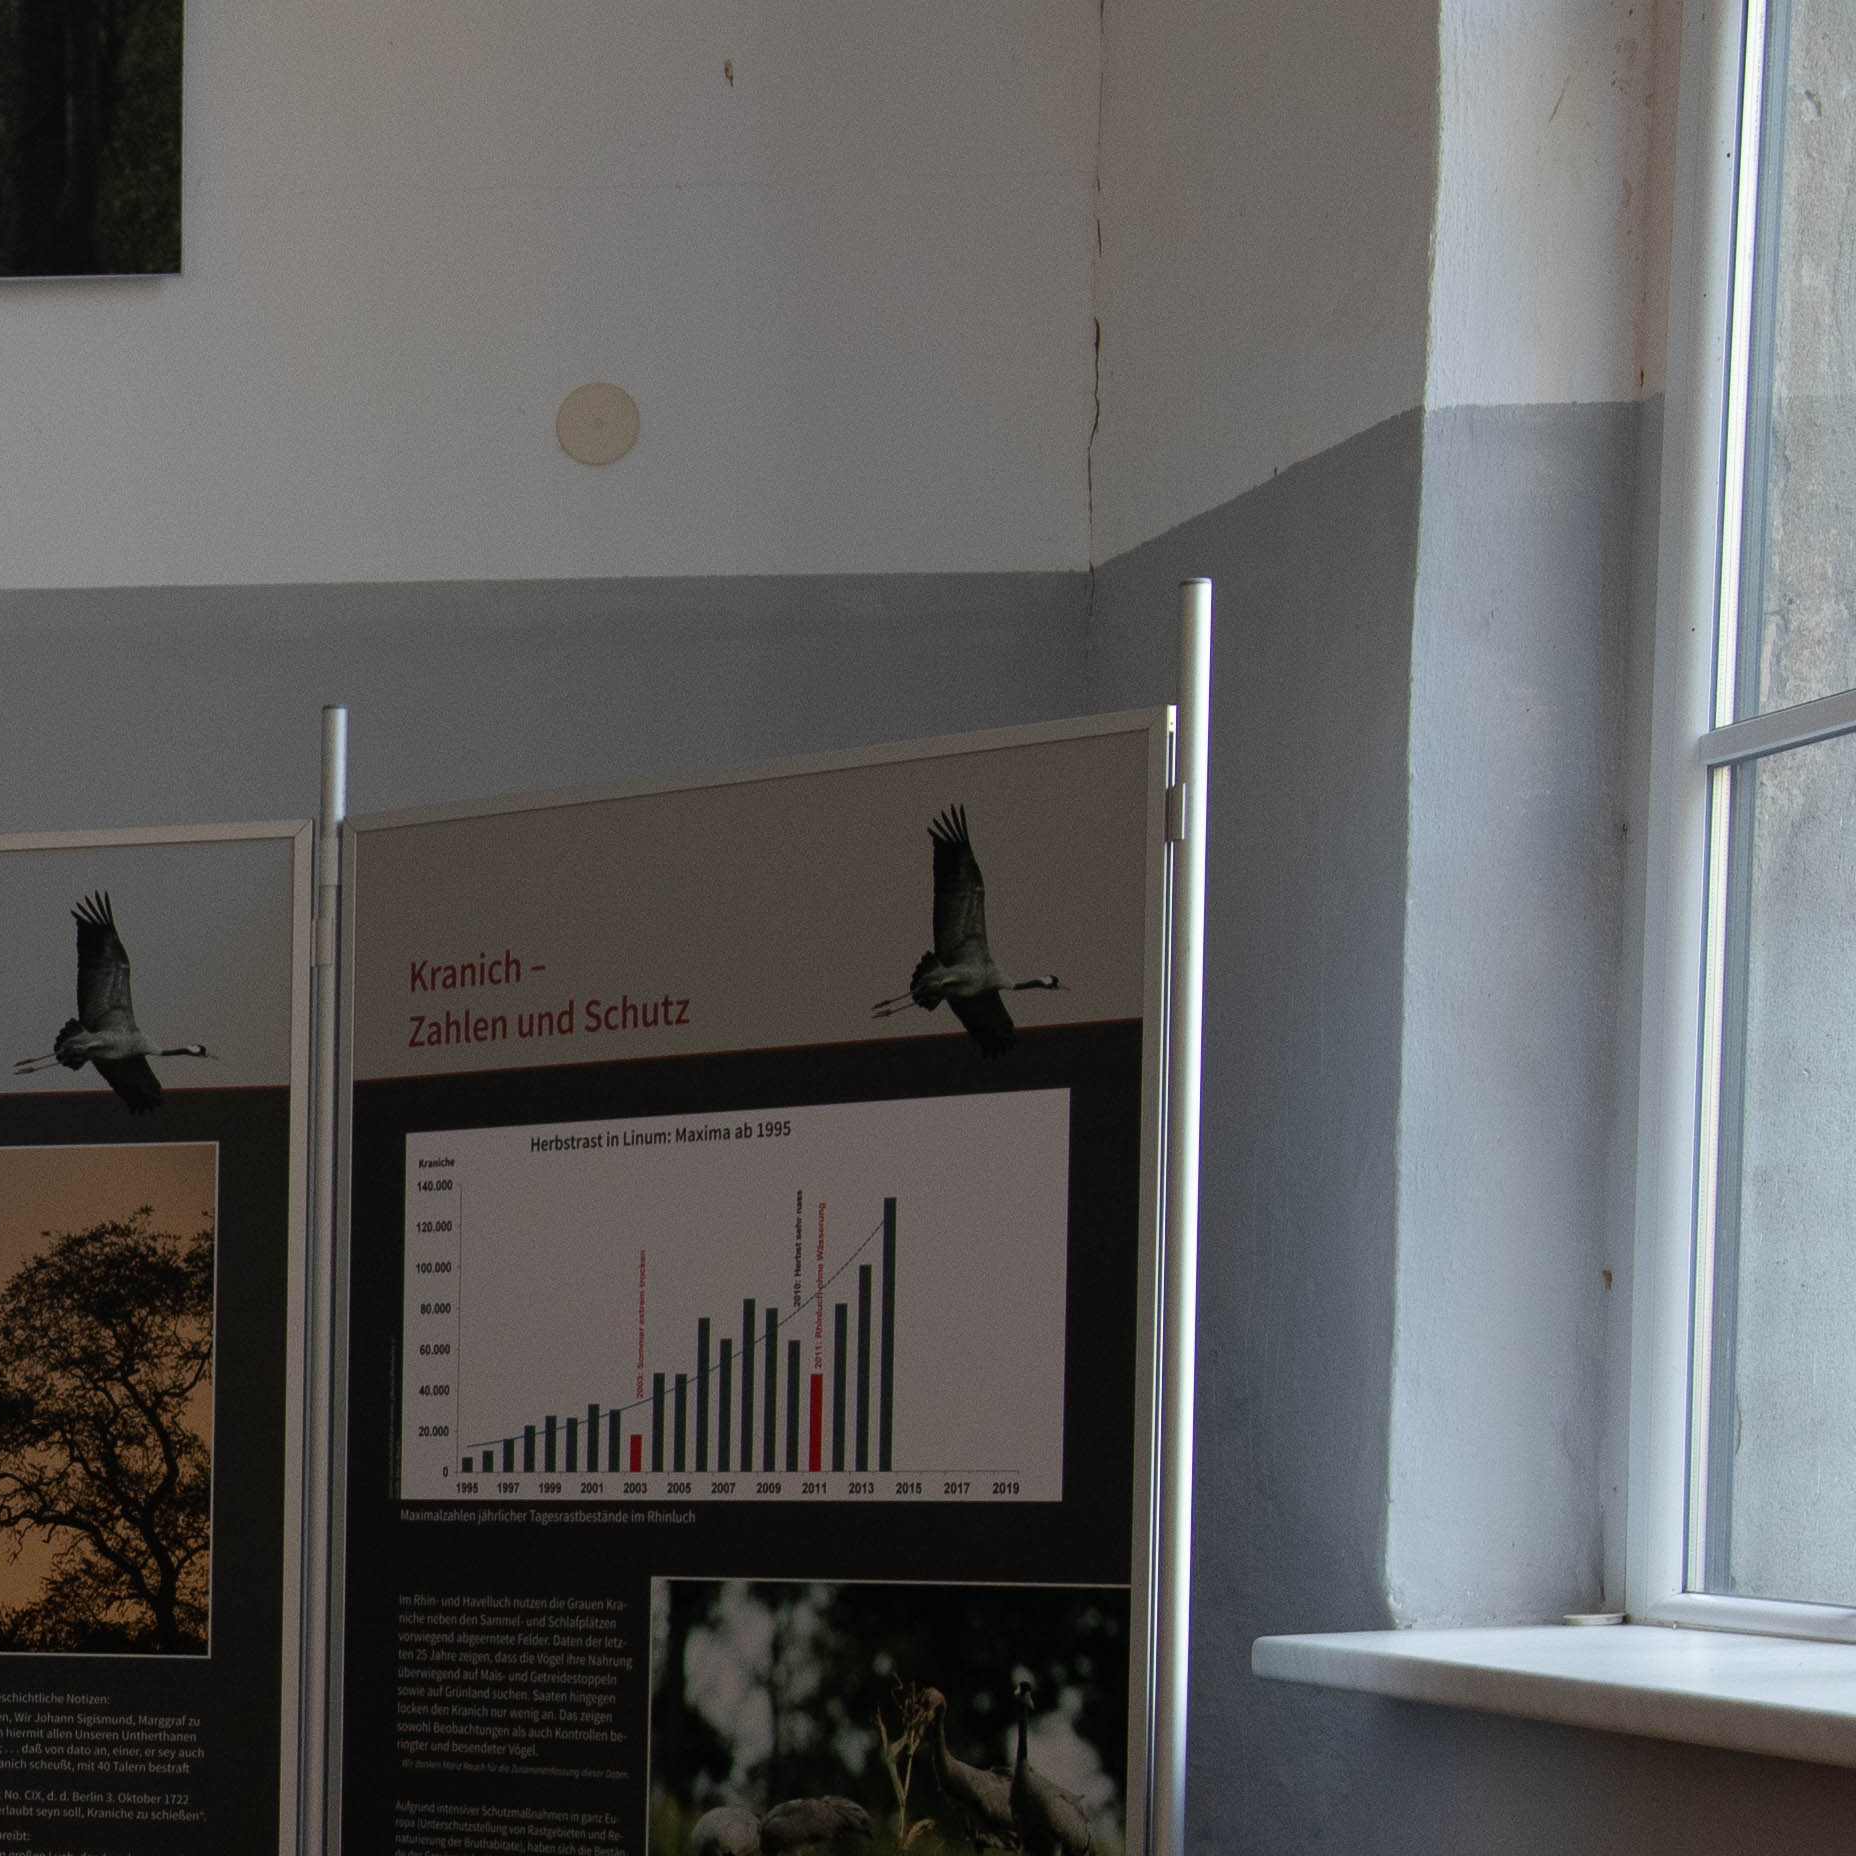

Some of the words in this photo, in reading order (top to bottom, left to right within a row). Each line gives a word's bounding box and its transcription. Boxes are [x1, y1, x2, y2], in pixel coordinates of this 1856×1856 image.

[410, 950, 521, 992] Kranich
[408, 1011, 507, 1048] Zahlen
[518, 999, 574, 1038] und
[585, 995, 689, 1032] Schutz
[530, 1134, 603, 1151] Herbstrast
[606, 1131, 619, 1147] in
[623, 1131, 671, 1146] Linum:
[675, 1124, 731, 1142] Maxima
[734, 1122, 753, 1139] ab
[757, 1120, 791, 1138] 1995
[418, 1157, 455, 1169] Kraniche
[417, 1180, 453, 1192] 140.000
[416, 1220, 452, 1233] 120.000
[416, 1262, 452, 1274] 100.000
[420, 1303, 451, 1314] 80.000
[419, 1344, 451, 1355] 60.000
[419, 1385, 450, 1396] 40.000
[418, 1425, 449, 1437] 20.000
[456, 1482, 479, 1494] 1995
[497, 1482, 520, 1494] 1997
[539, 1482, 562, 1494] 1999
[580, 1482, 604, 1494] 2001
[623, 1482, 647, 1494] 2003
[667, 1482, 691, 1494] 2005
[711, 1482, 736, 1494] 2007
[756, 1482, 781, 1494] 2009
[802, 1482, 827, 1494] 2011
[848, 1482, 874, 1494] 2013
[895, 1482, 922, 1494] 2015
[944, 1482, 970, 1494] 2017
[992, 1482, 1020, 1494] 2019
[400, 1509, 477, 1522] Maximalzahlen
[477, 1508, 528, 1525] jährlicher
[529, 1509, 630, 1525] Tagesrastbestände
[631, 1510, 645, 1523] im
[646, 1510, 696, 1524] Rhinluch
